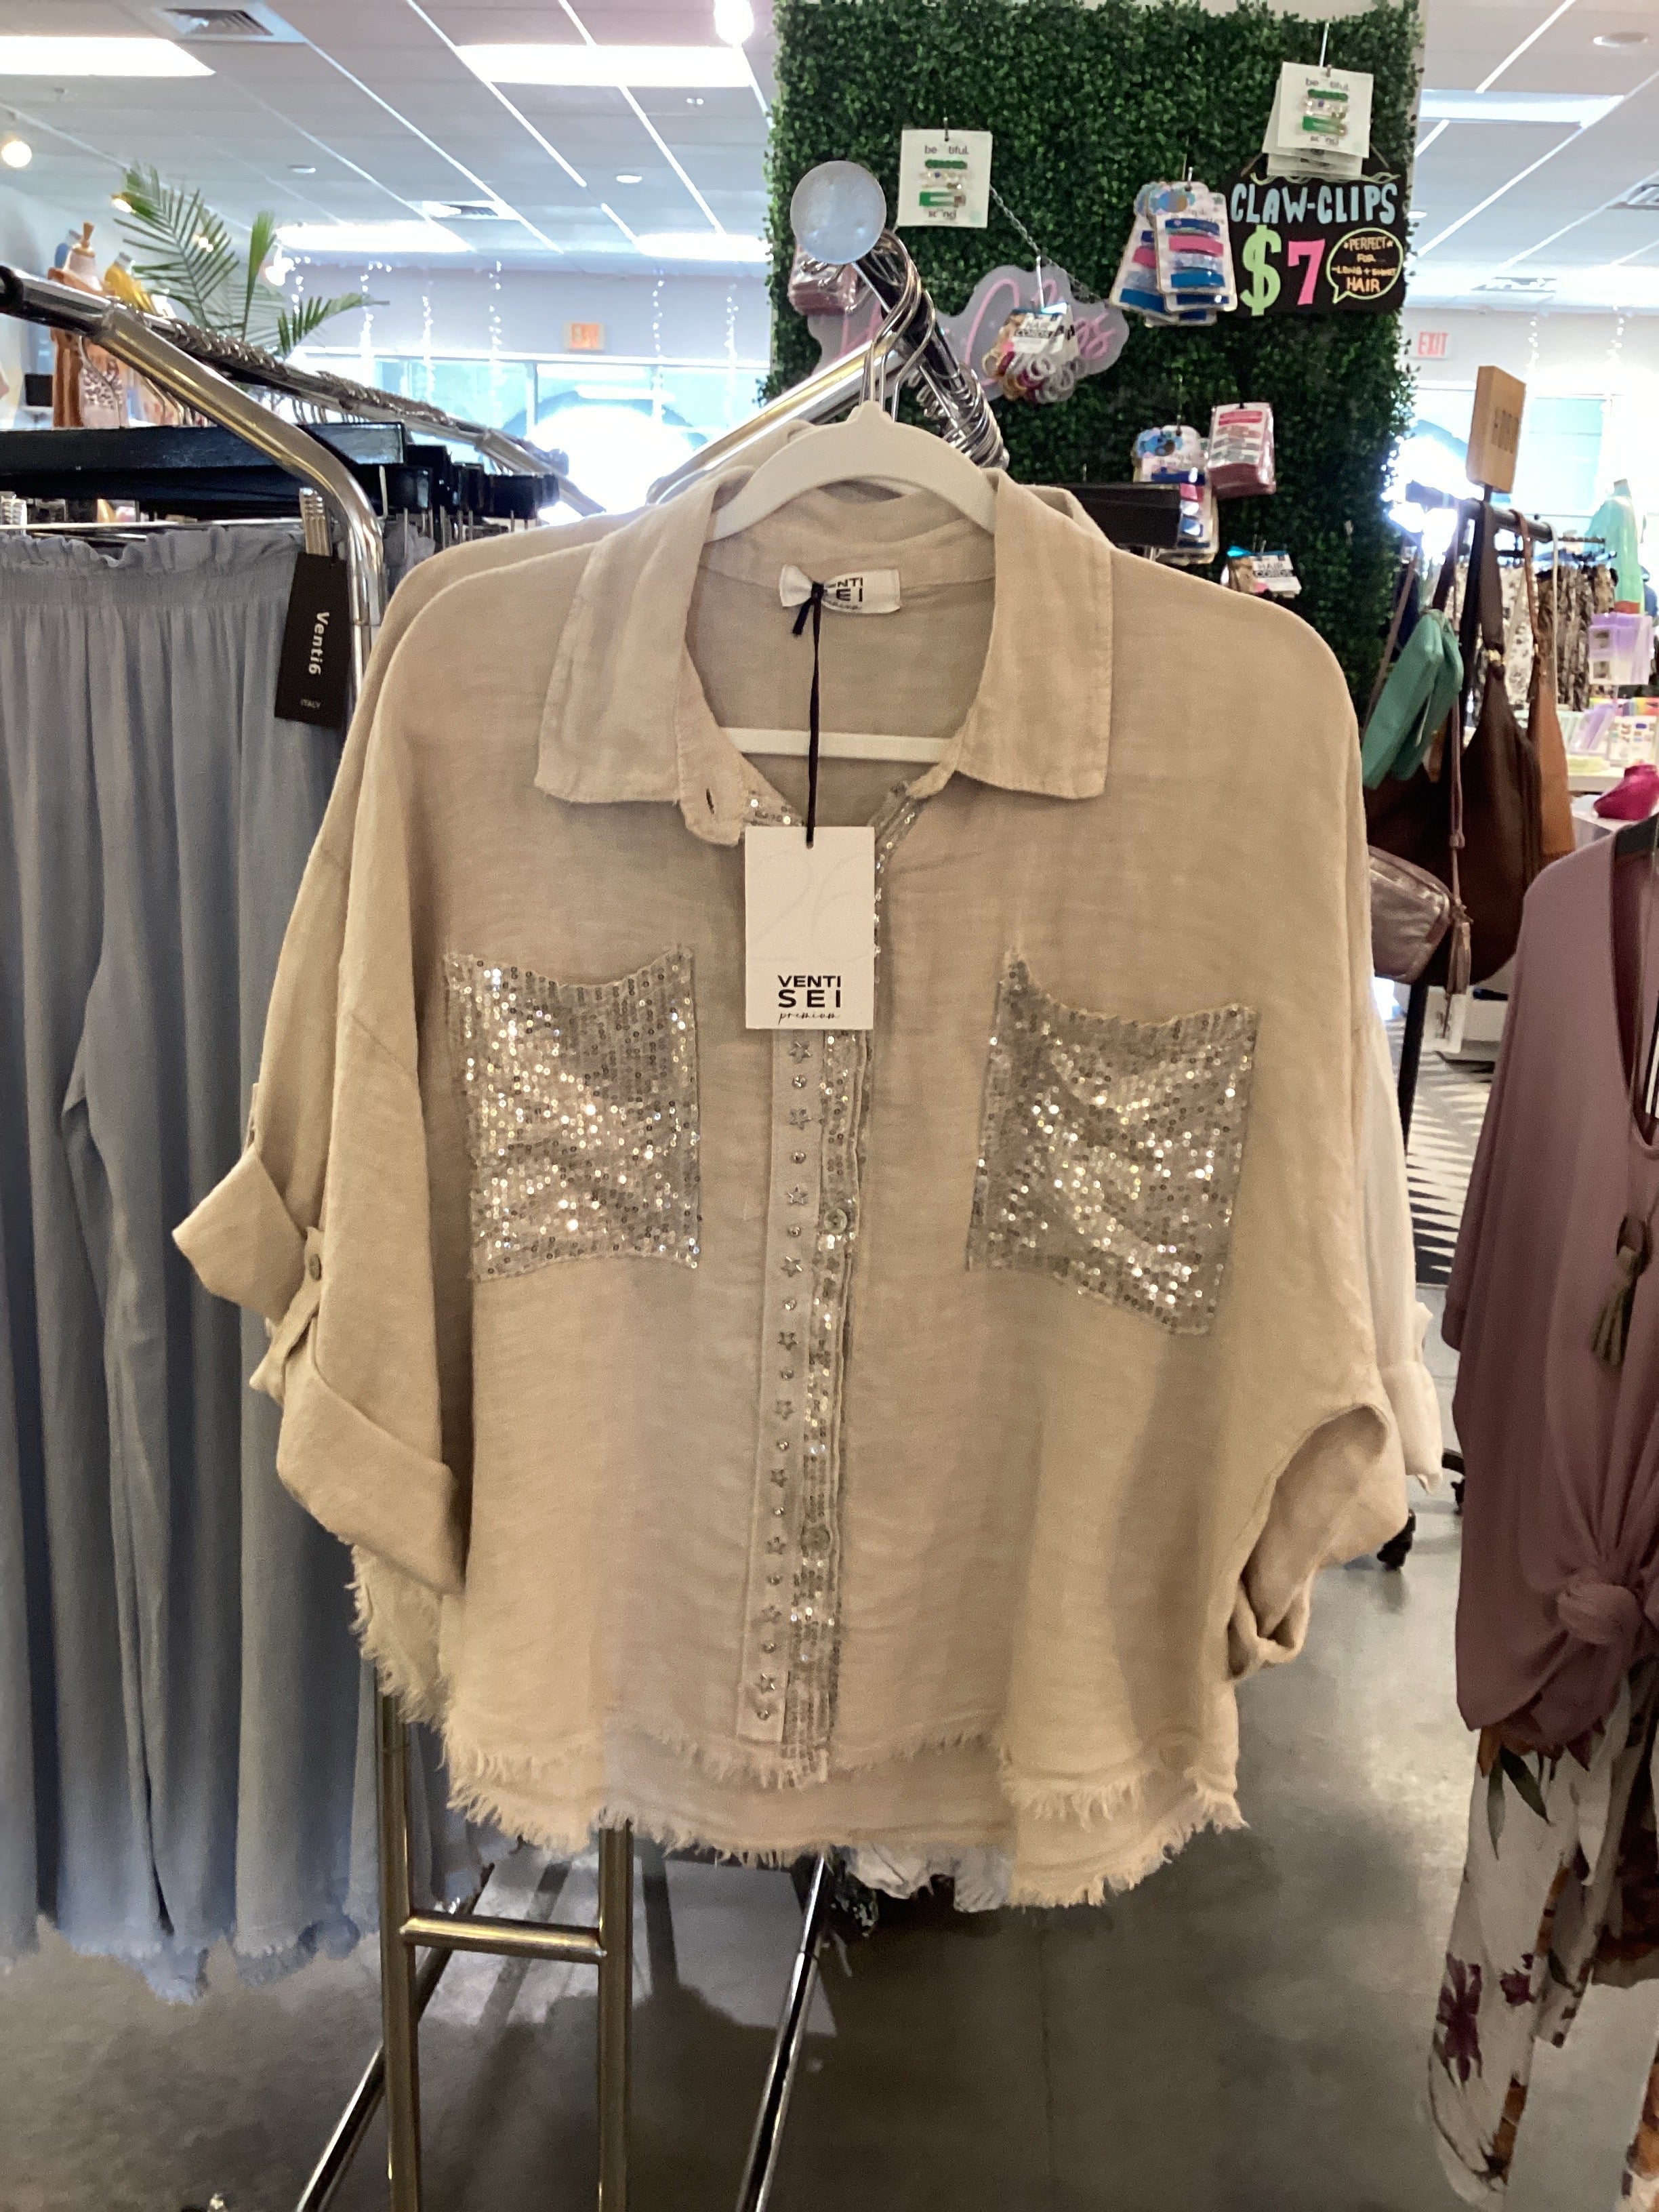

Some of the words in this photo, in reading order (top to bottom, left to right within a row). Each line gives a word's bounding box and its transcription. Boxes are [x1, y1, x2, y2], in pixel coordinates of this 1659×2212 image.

[1231, 182, 1398, 225] CLAW-CLIPS
[1349, 236, 1387, 251] PERFECT
[1346, 276, 1380, 293] HAIR
[1418, 332, 1449, 356] EXIT
[308, 611, 330, 676] Venti6
[777, 975, 841, 987] VENTI
[777, 989, 841, 1008] SEI
